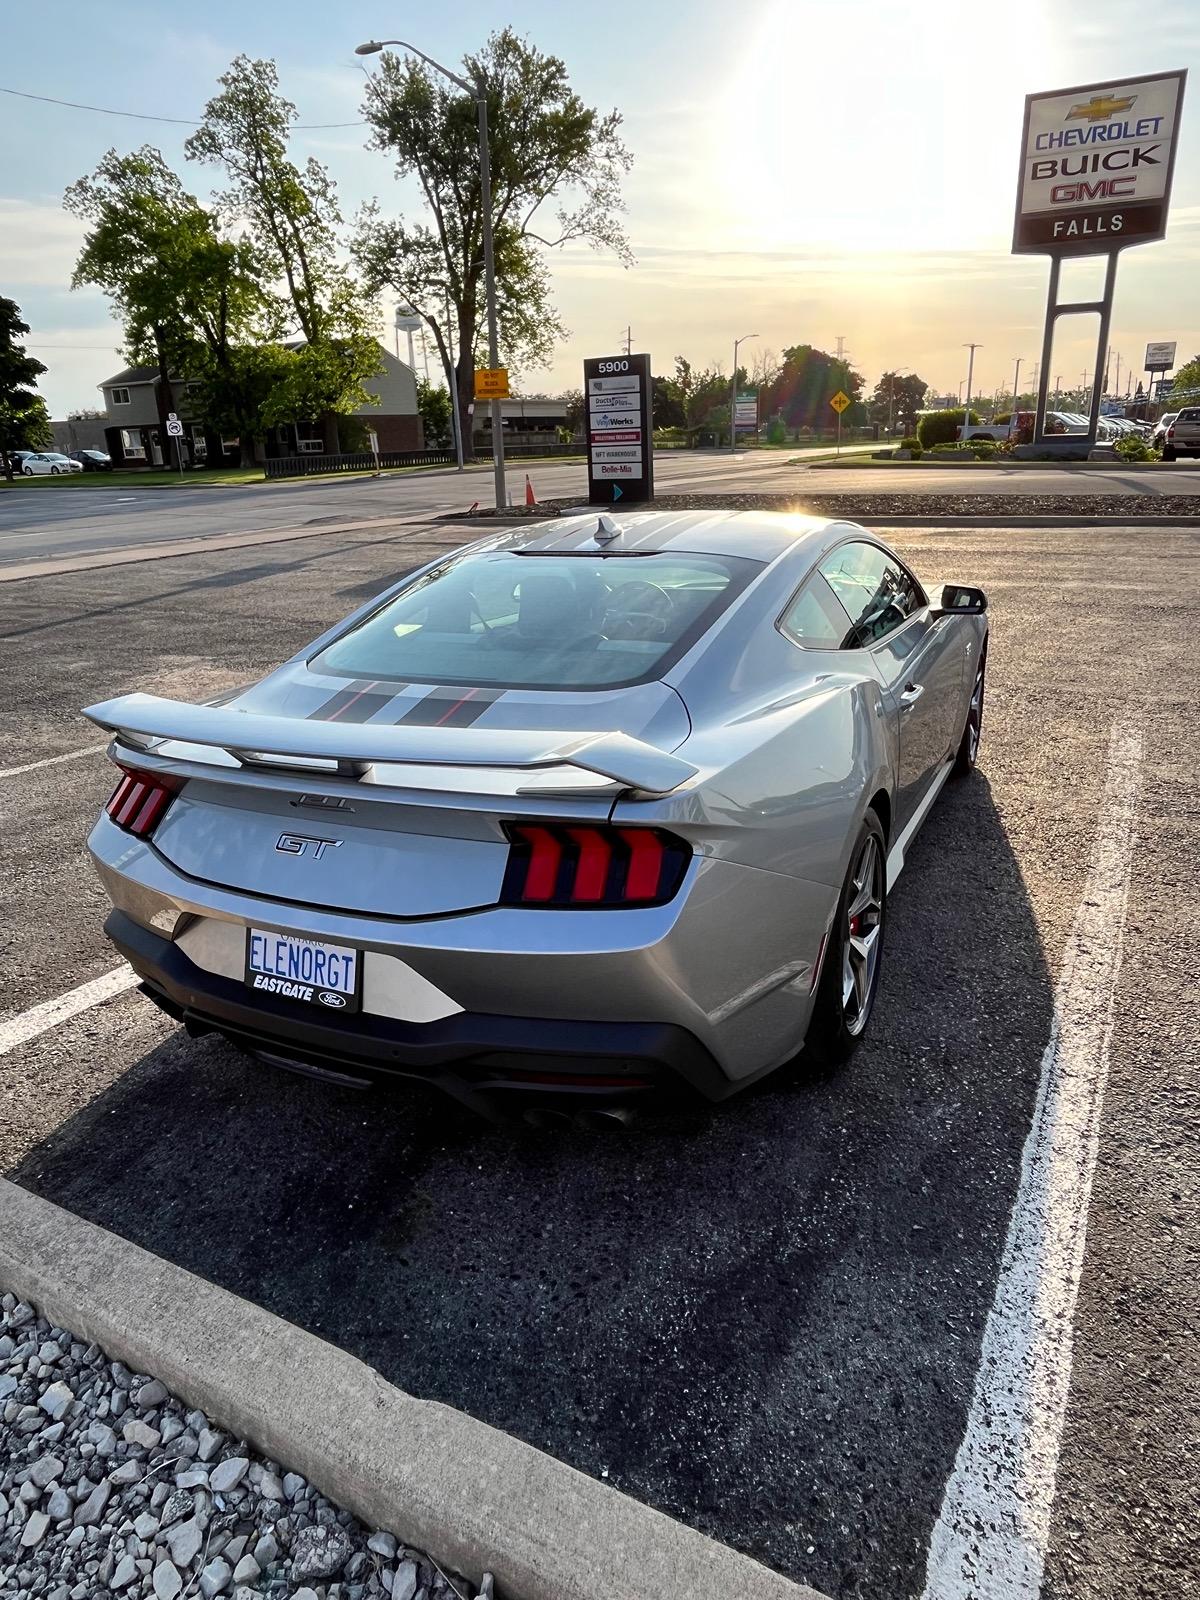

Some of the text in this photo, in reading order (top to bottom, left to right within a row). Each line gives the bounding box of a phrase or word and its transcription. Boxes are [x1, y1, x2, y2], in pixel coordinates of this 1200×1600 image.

[1035, 116, 1164, 151] CHEVROLET
[1031, 144, 1162, 181] BUICK
[1050, 175, 1137, 204] GMC
[1053, 214, 1123, 237] FALLS
[598, 360, 629, 373] 5900
[276, 831, 344, 861] GT
[250, 935, 354, 992] ELENORGT
[253, 974, 314, 1002] EASTGATE
